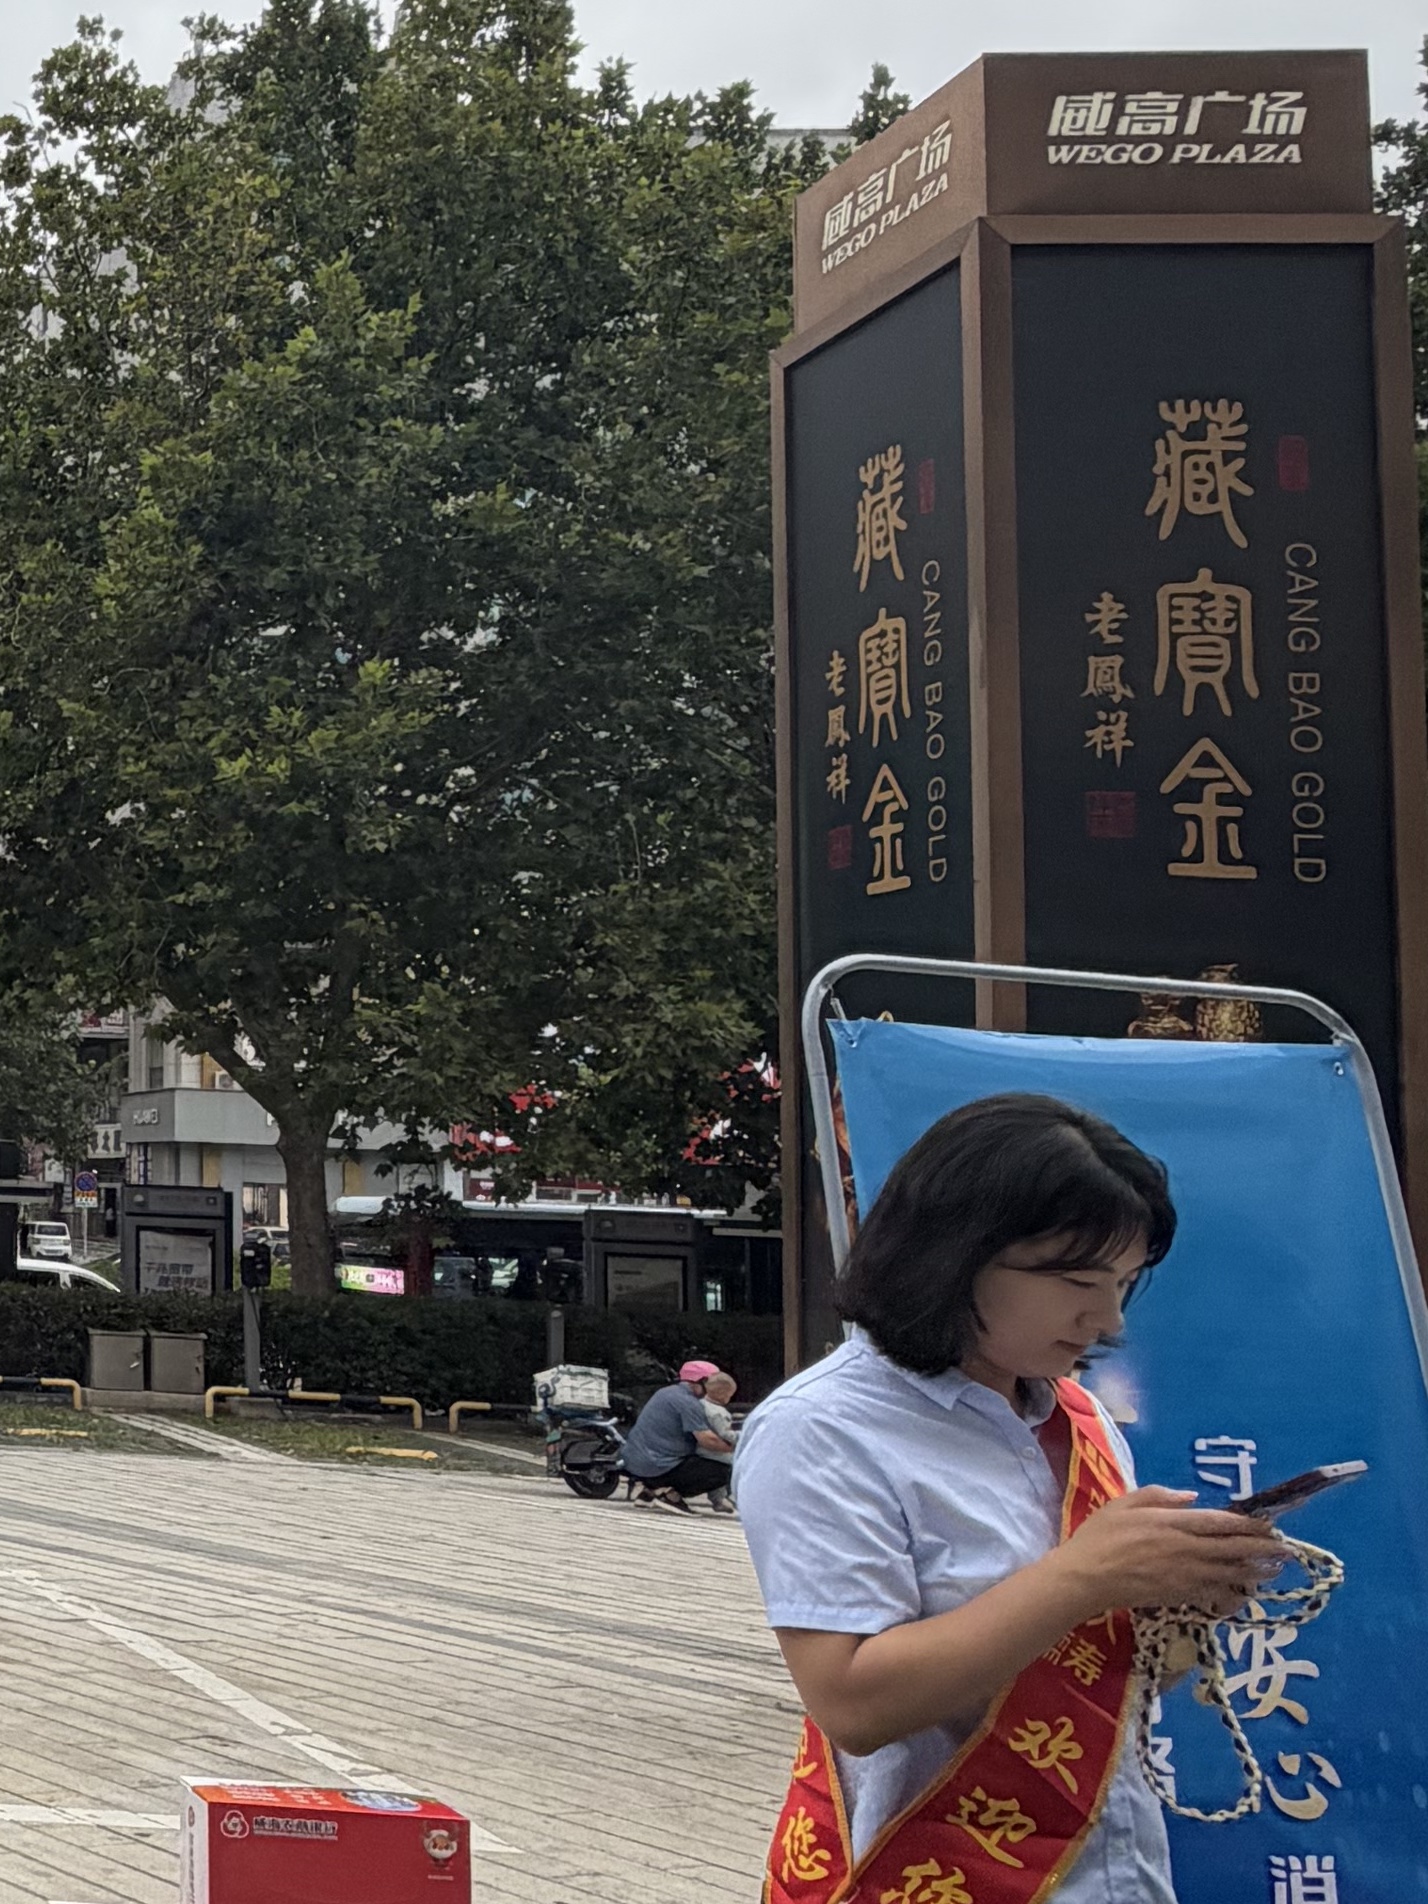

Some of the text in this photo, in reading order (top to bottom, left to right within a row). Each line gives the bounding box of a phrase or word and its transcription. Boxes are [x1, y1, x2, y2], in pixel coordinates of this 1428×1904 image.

[1047, 90, 1309, 137] 威高广场
[1047, 142, 1305, 166] WEGO PLAZA
[821, 119, 952, 251] 威高广场
[821, 172, 949, 274] WEGO PLAZA
[920, 560, 948, 883] CANG BAO GOLD
[1284, 542, 1327, 883] CANG BAO GOLD
